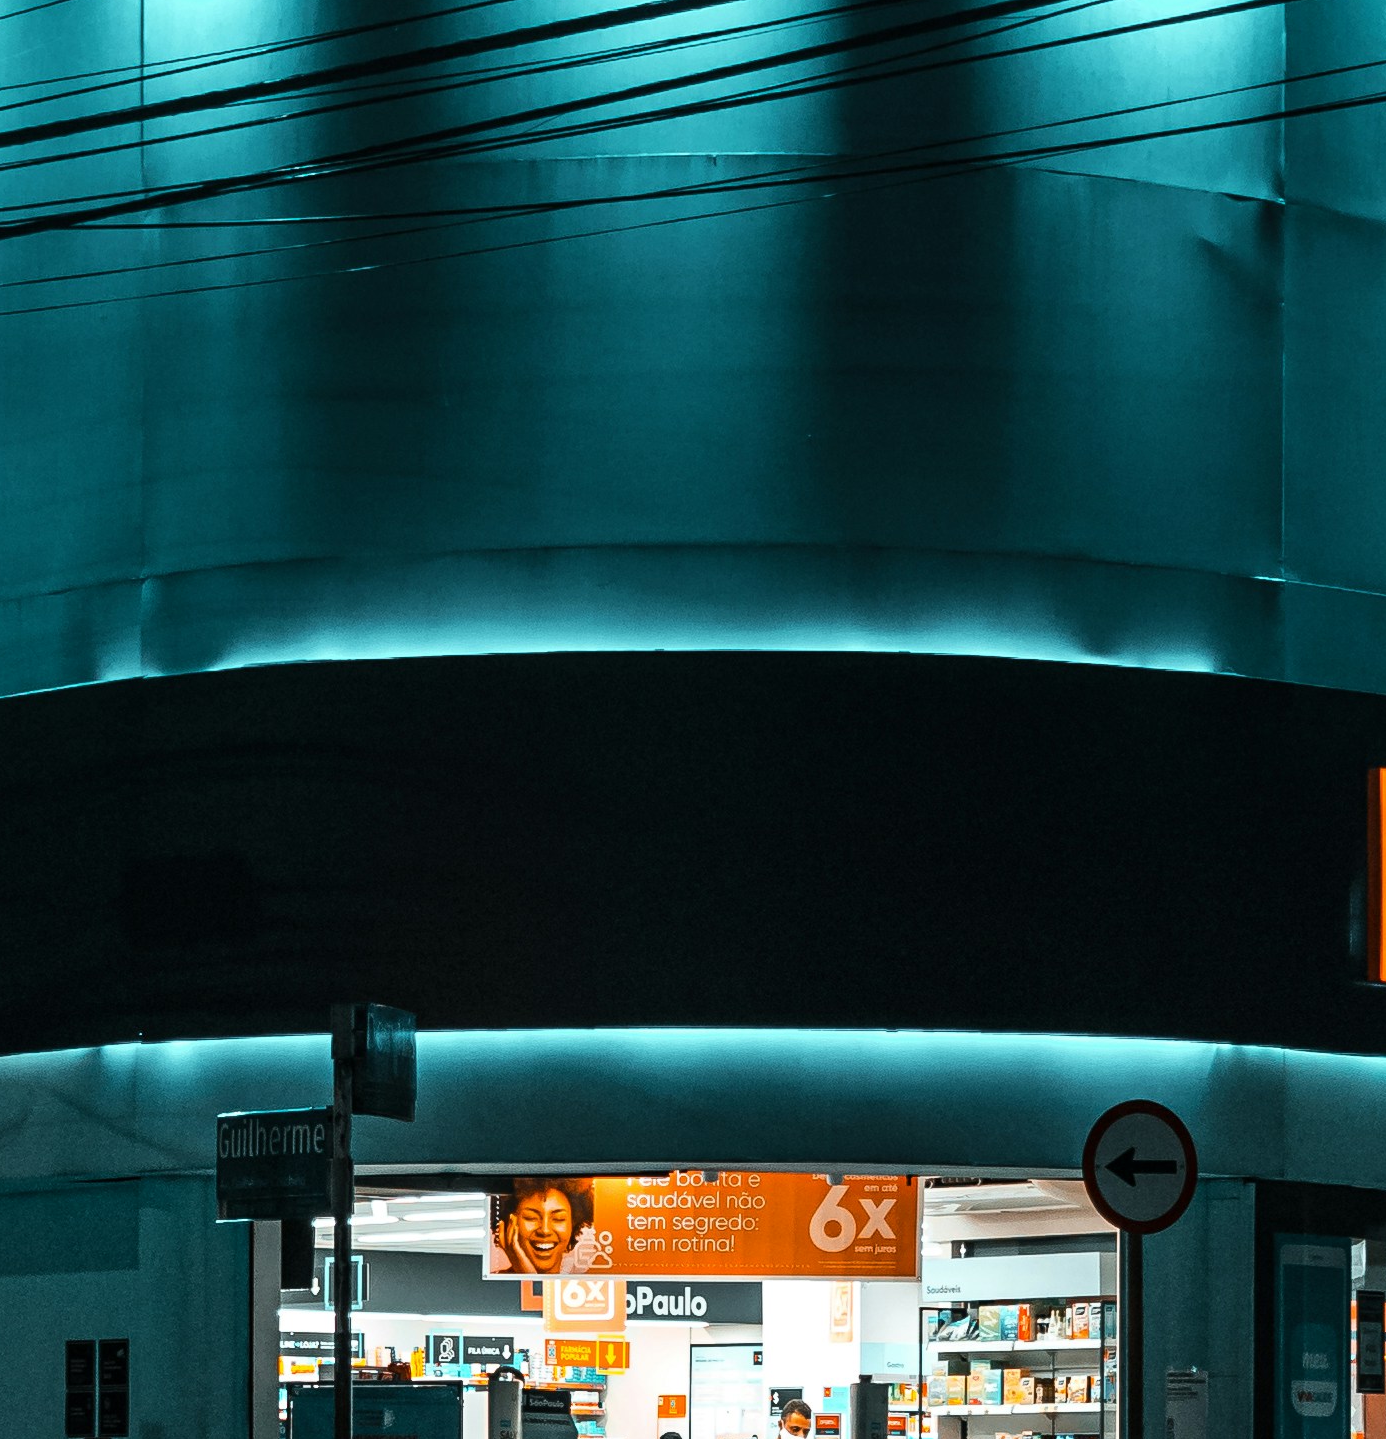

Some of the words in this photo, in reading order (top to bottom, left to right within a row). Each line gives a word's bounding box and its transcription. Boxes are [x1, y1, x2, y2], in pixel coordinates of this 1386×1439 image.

[218, 1118, 327, 1159] Guilherme
[748, 1174, 761, 1188] e
[626, 1191, 721, 1209] saudável
[726, 1192, 766, 1209] não
[626, 1213, 666, 1230] tem
[673, 1213, 760, 1235] segredo:
[809, 1184, 898, 1253] 6x
[626, 1235, 666, 1252] tem
[673, 1234, 735, 1252] rotina!
[626, 1285, 709, 1317] oPaulo
